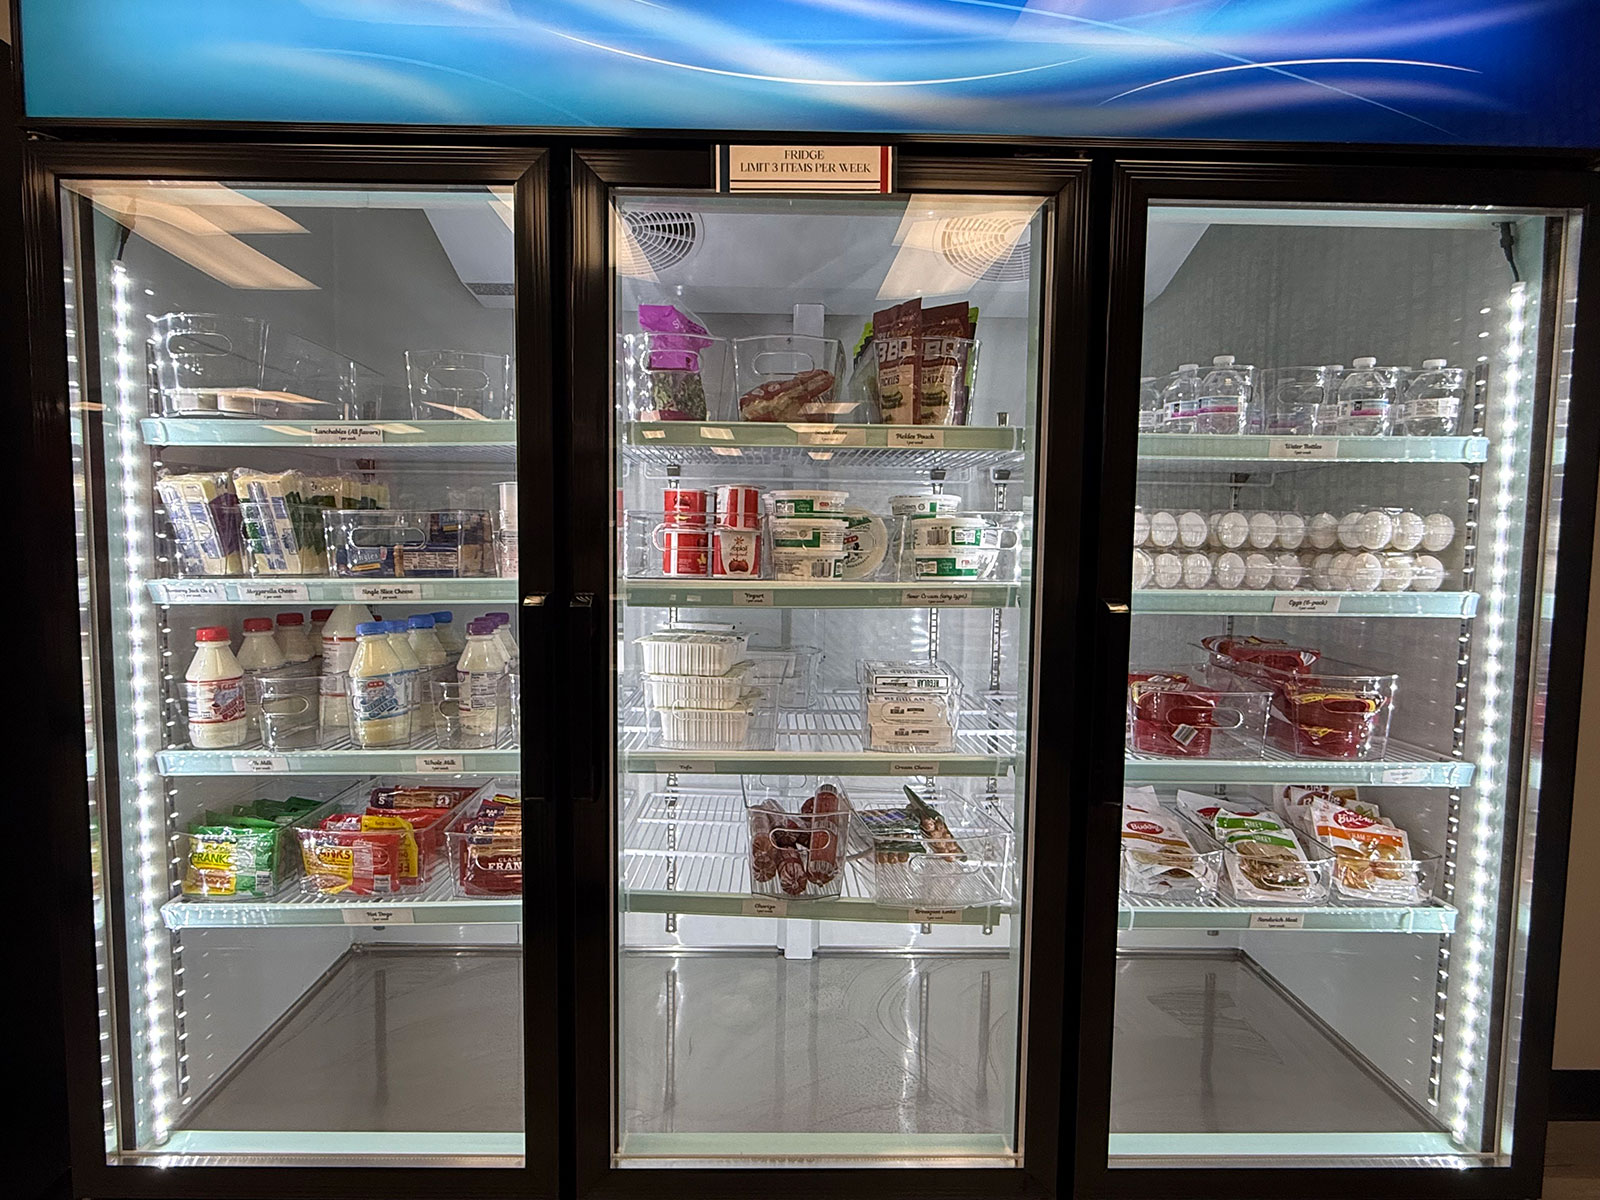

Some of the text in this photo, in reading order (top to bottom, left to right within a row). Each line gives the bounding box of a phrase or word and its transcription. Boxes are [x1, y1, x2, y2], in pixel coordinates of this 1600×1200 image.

[784, 150, 825, 160] FRIDGE
[740, 162, 871, 173] LIMIT 3 ITEMS PER WEEK
[1130, 823, 1162, 833] Buddig
[488, 862, 522, 870] FRAN
